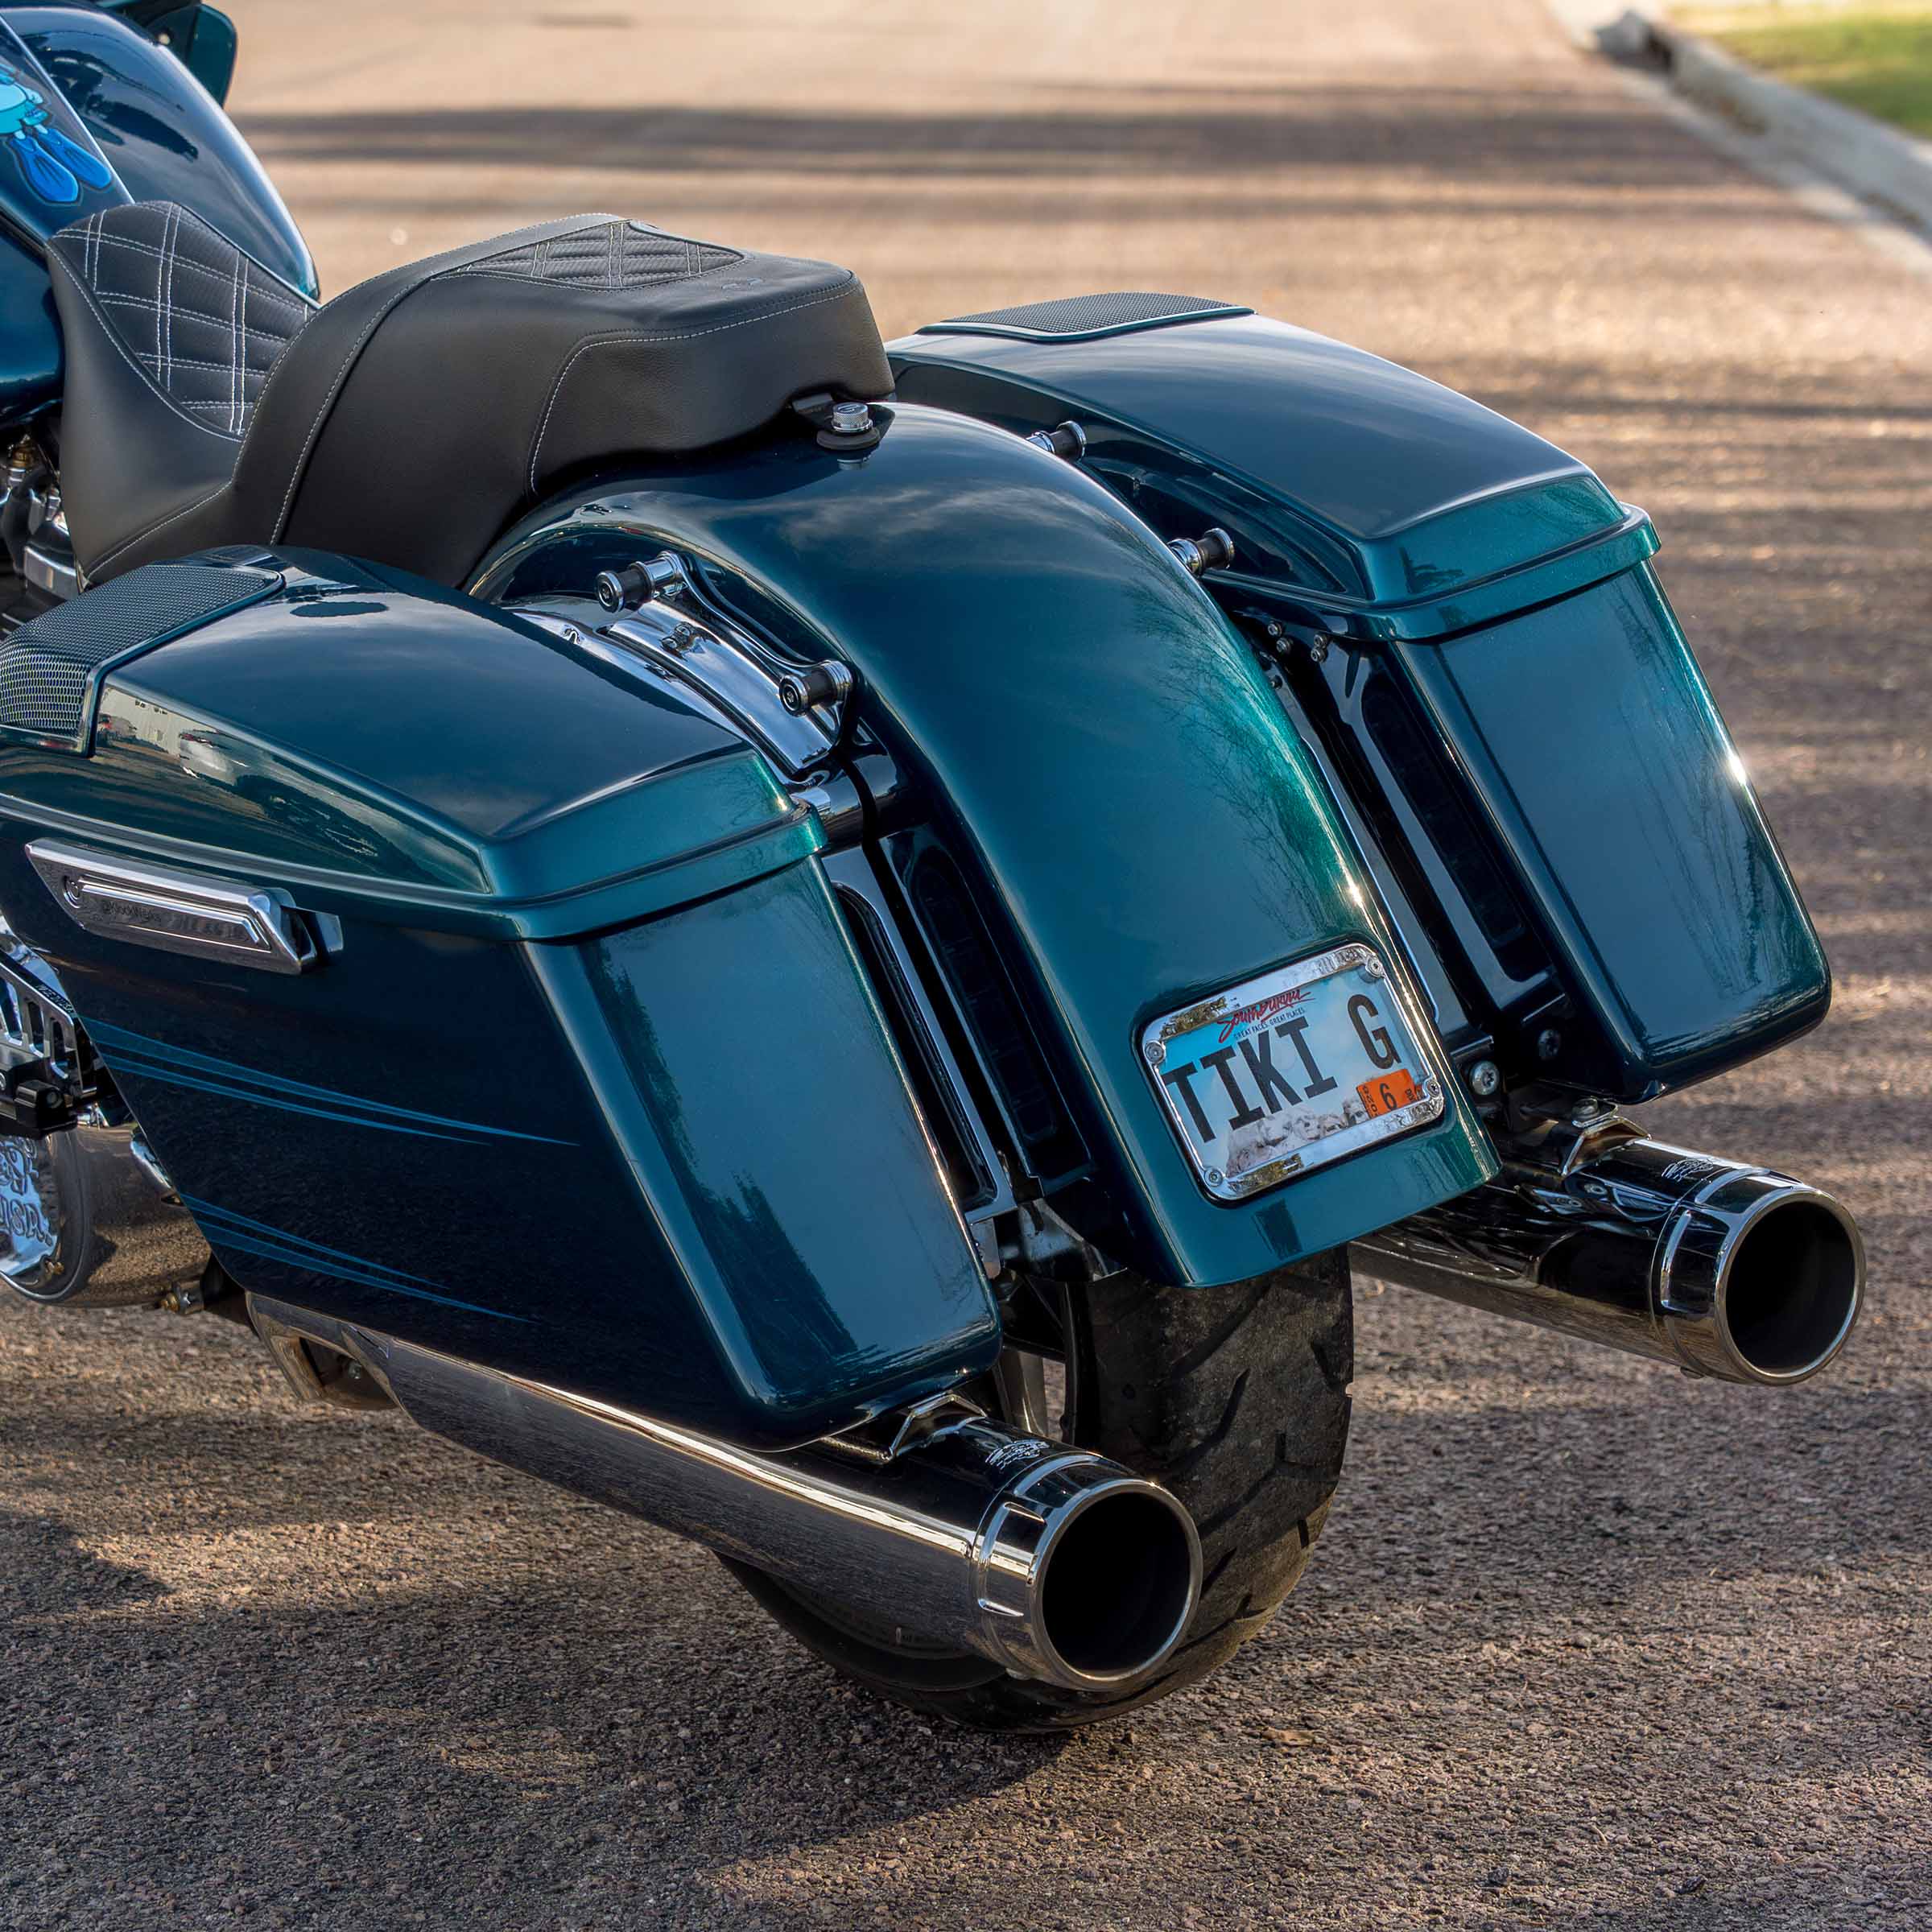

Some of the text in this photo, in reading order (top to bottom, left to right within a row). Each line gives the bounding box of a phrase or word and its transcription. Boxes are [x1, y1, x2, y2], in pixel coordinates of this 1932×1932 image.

[1269, 1014, 1286, 1026] GREAT
[1162, 993, 1402, 1143] TIKI G
[1379, 1083, 1397, 1112] 6
